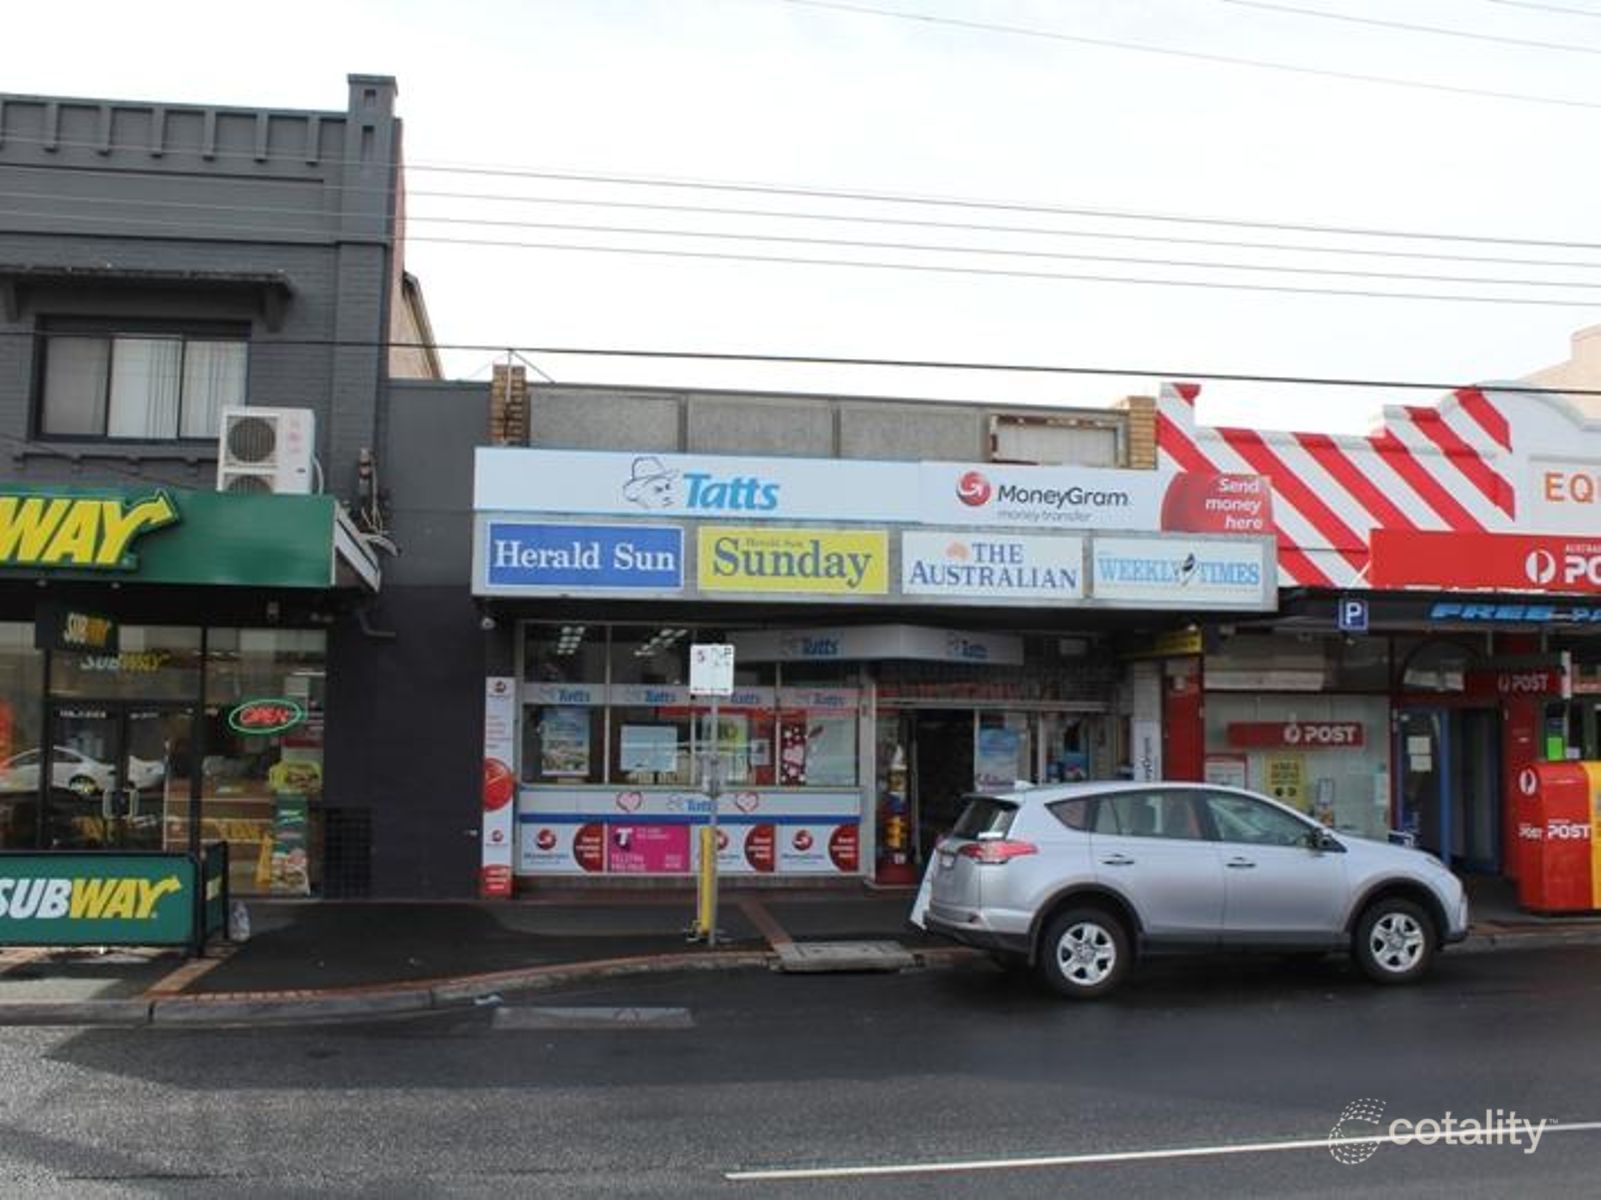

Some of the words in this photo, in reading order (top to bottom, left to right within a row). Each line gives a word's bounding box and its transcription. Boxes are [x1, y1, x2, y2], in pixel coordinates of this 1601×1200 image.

[683, 473, 780, 511] Tatts
[998, 484, 1129, 509] MoneyGram
[1219, 478, 1260, 494] Send
[1544, 471, 1601, 504] EQ
[1205, 498, 1262, 515] money
[1225, 514, 1263, 530] here
[493, 538, 601, 571] Herald
[613, 542, 676, 572] Sun
[713, 536, 873, 588] Sunday
[971, 542, 1025, 564] THE
[909, 559, 1077, 590] AUSTRALIAN
[1098, 557, 1182, 582] WEEKLY
[1200, 561, 1260, 586] TIMES
[1346, 602, 1363, 624] P
[1511, 673, 1548, 691] POST
[1304, 725, 1357, 743] POST
[1546, 824, 1590, 839] POST
[0, 876, 182, 919] SUBWAY
